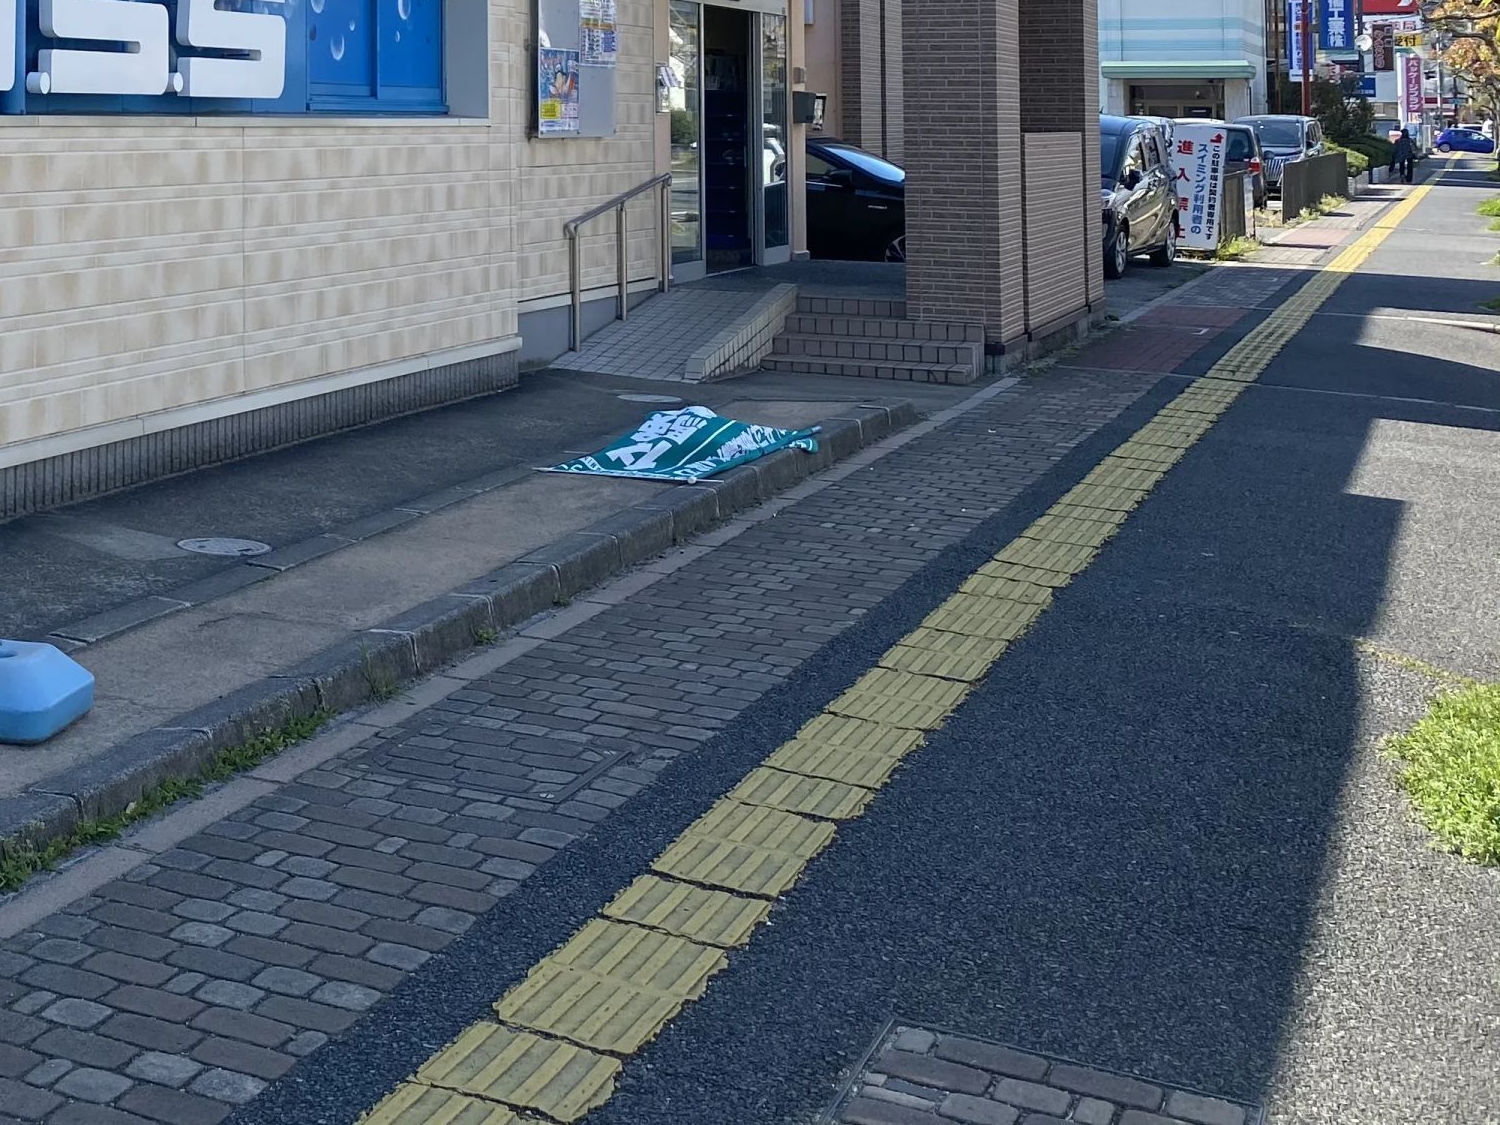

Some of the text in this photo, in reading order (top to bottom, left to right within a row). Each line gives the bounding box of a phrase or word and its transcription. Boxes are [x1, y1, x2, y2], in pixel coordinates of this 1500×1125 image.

[1190, 143, 1208, 235] スイミング利用者の
